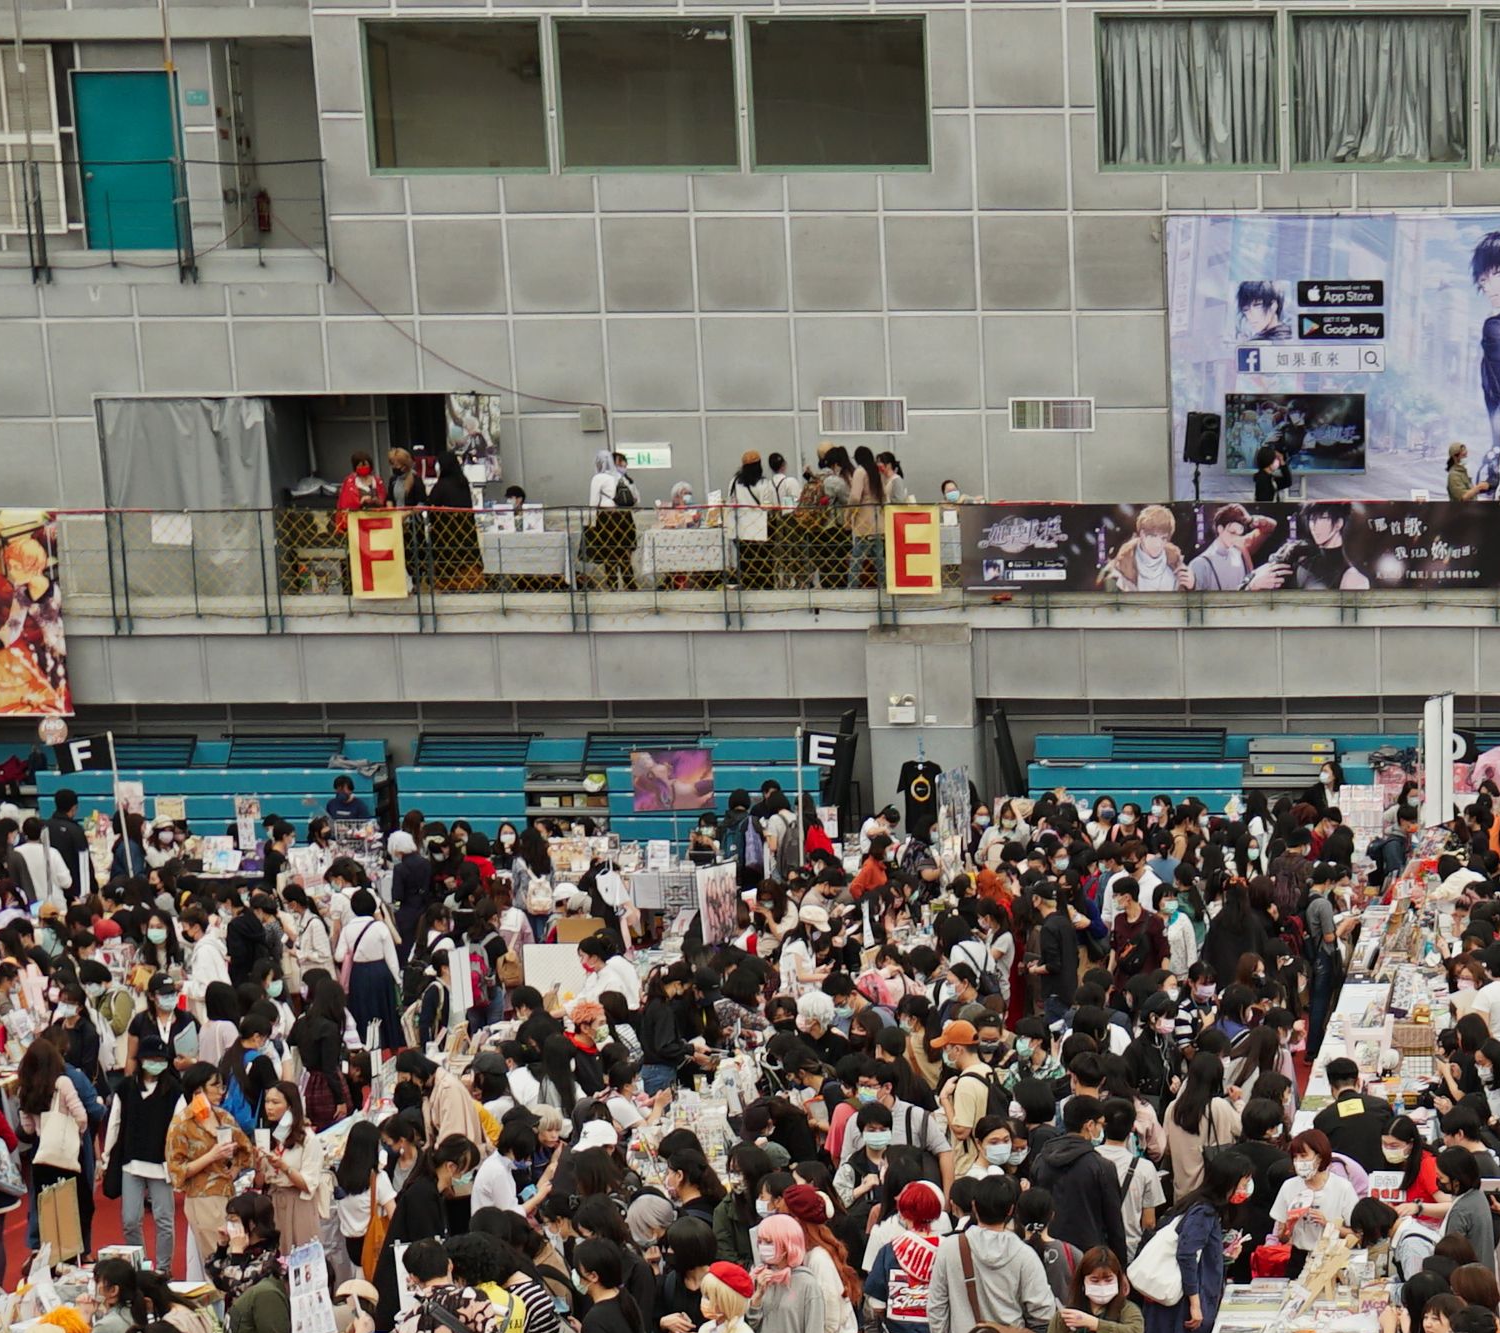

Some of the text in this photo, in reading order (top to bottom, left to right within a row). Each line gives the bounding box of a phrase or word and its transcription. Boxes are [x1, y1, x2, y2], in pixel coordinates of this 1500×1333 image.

[1323, 291, 1374, 303] App Store
[1322, 323, 1380, 337] Google Play
[1276, 351, 1340, 367] 如果重來
[357, 517, 395, 592] F
[894, 512, 933, 587] E
[70, 740, 92, 770] F
[808, 734, 837, 767] E
